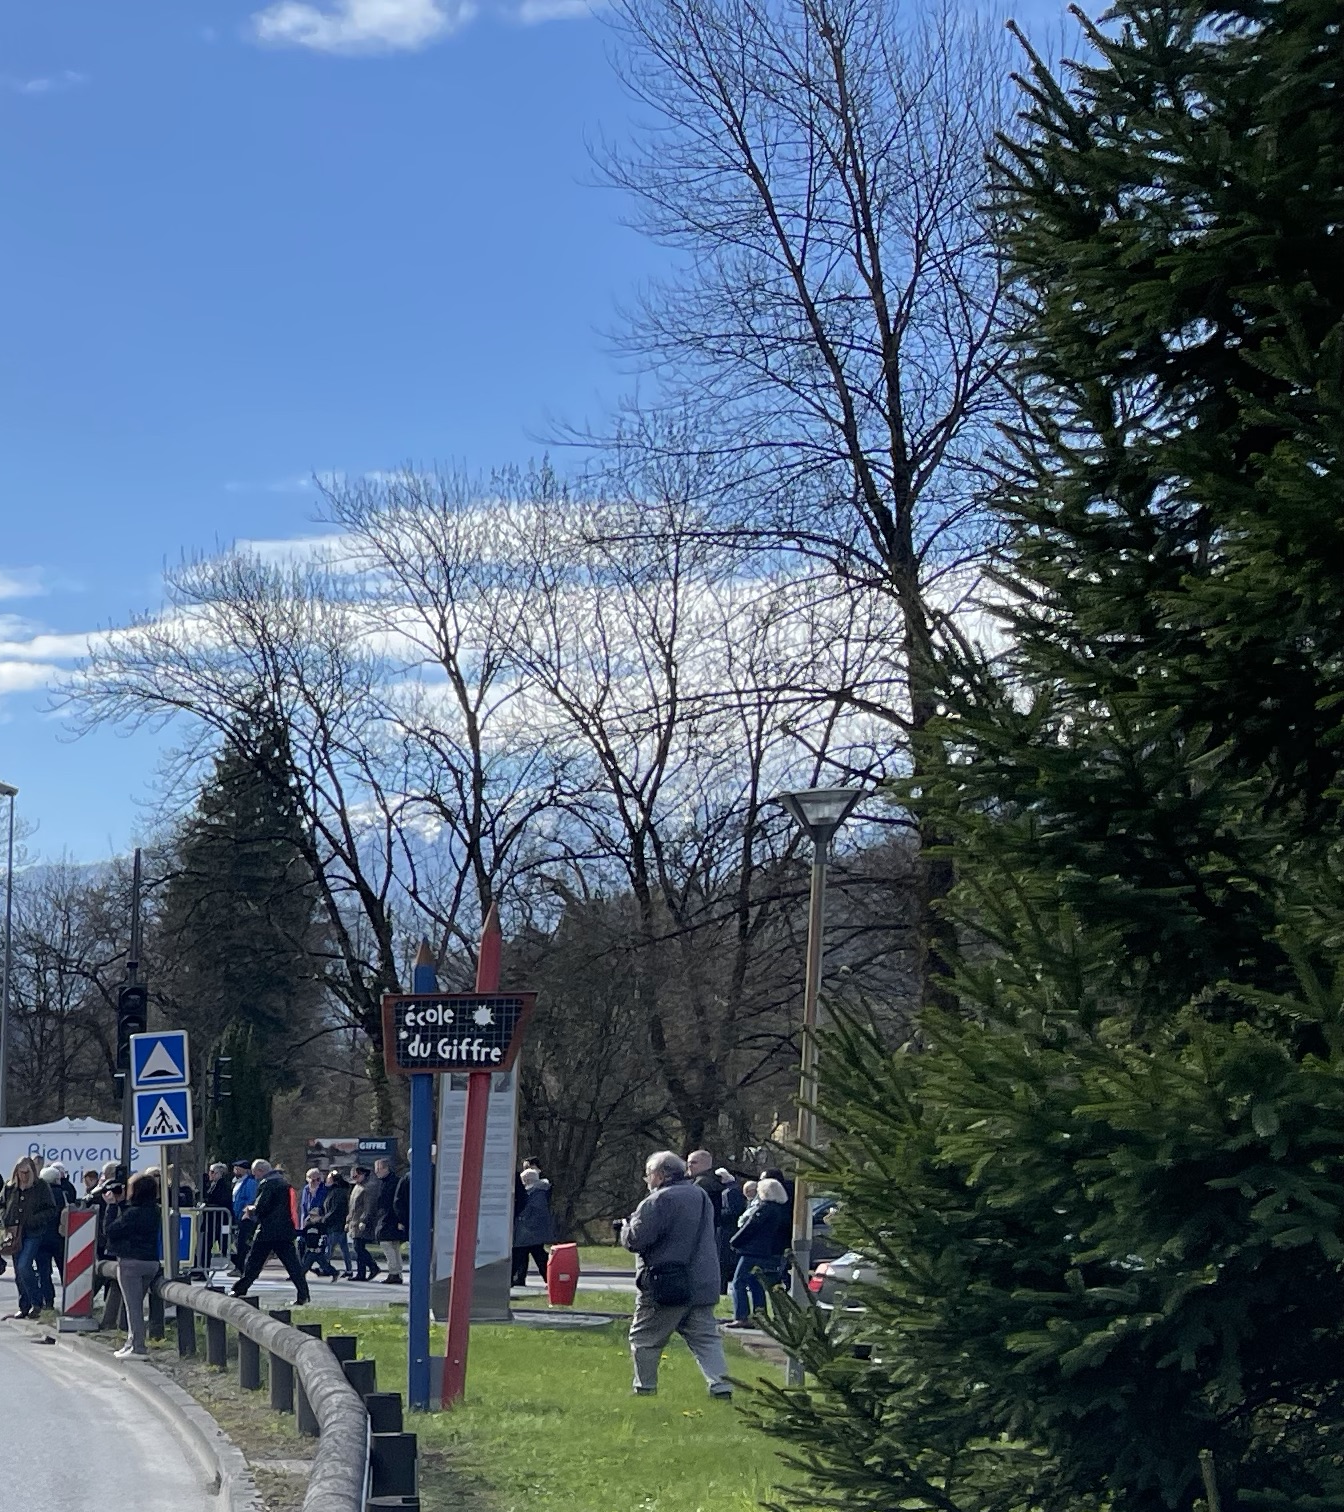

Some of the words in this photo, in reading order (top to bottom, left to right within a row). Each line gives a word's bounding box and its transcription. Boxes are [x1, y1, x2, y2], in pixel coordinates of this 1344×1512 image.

[405, 1004, 454, 1026] école
[408, 1033, 431, 1058] du
[437, 1038, 502, 1062] Giffre
